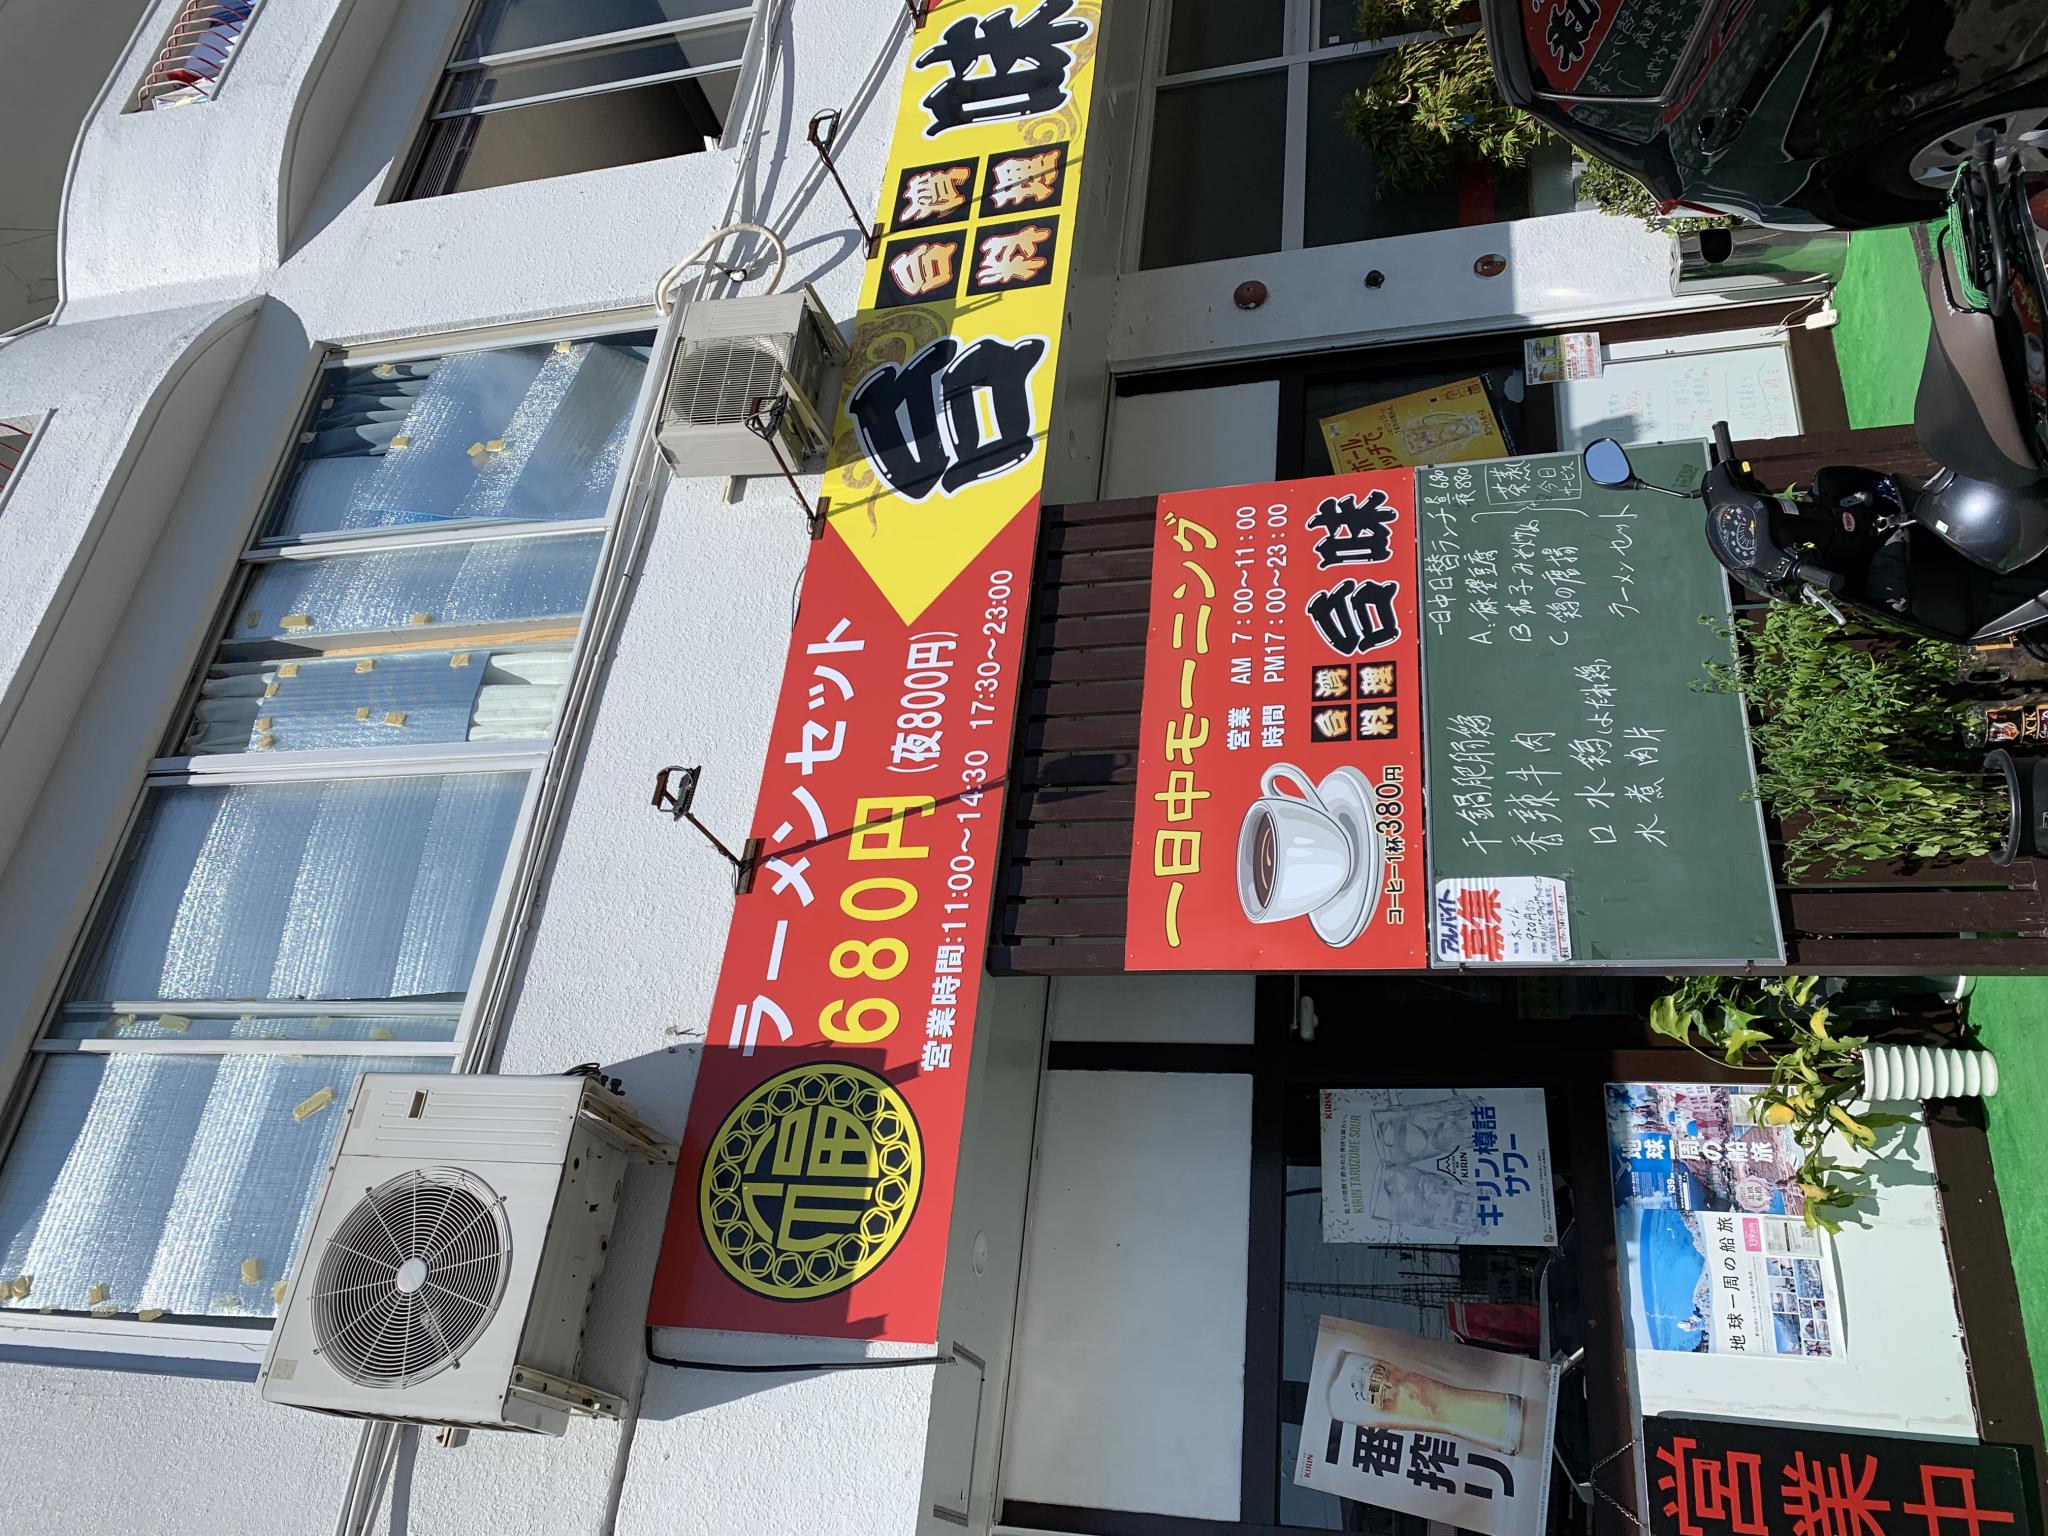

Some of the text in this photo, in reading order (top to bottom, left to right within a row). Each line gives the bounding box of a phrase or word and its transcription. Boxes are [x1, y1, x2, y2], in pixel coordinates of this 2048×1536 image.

[843, 0, 1093, 503] 台 味
[888, 165, 971, 297] 台湾
[975, 148, 1062, 286] 料理
[1429, 469, 1449, 489] 680
[1453, 467, 1469, 489] 880
[1305, 489, 1401, 656] 台味
[1598, 504, 1640, 617] ラーメンセット
[1508, 623, 1532, 642] B
[1549, 631, 1569, 645] C
[1230, 657, 1253, 685] AM
[1358, 661, 1397, 737] 料理
[1153, 511, 1218, 949] 一日中モーニング
[1227, 705, 1252, 751] 営業
[1261, 704, 1287, 748] 時間
[728, 617, 865, 1057] ラーメンセット
[819, 795, 936, 1044] 680円
[1438, 889, 1459, 954] アルバイト
[1456, 888, 1505, 961] 募集
[1324, 1092, 1333, 1120] KIRIN
[1349, 1115, 1365, 1214] KIRIN TARUZUME SOUR
[1459, 1151, 1469, 1178] KIRIN
[1471, 1106, 1503, 1226] キリン樽詰
[1503, 1133, 1531, 1197] サワー
[1622, 1138, 1774, 1163] 地球一周の船旅
[1716, 1216, 1746, 1351] 地球一周の船旅
[1303, 1452, 1314, 1479] KIRIN
[1325, 1418, 1515, 1499] 一番搾り
[1655, 1436, 2015, 1536] 営業中
